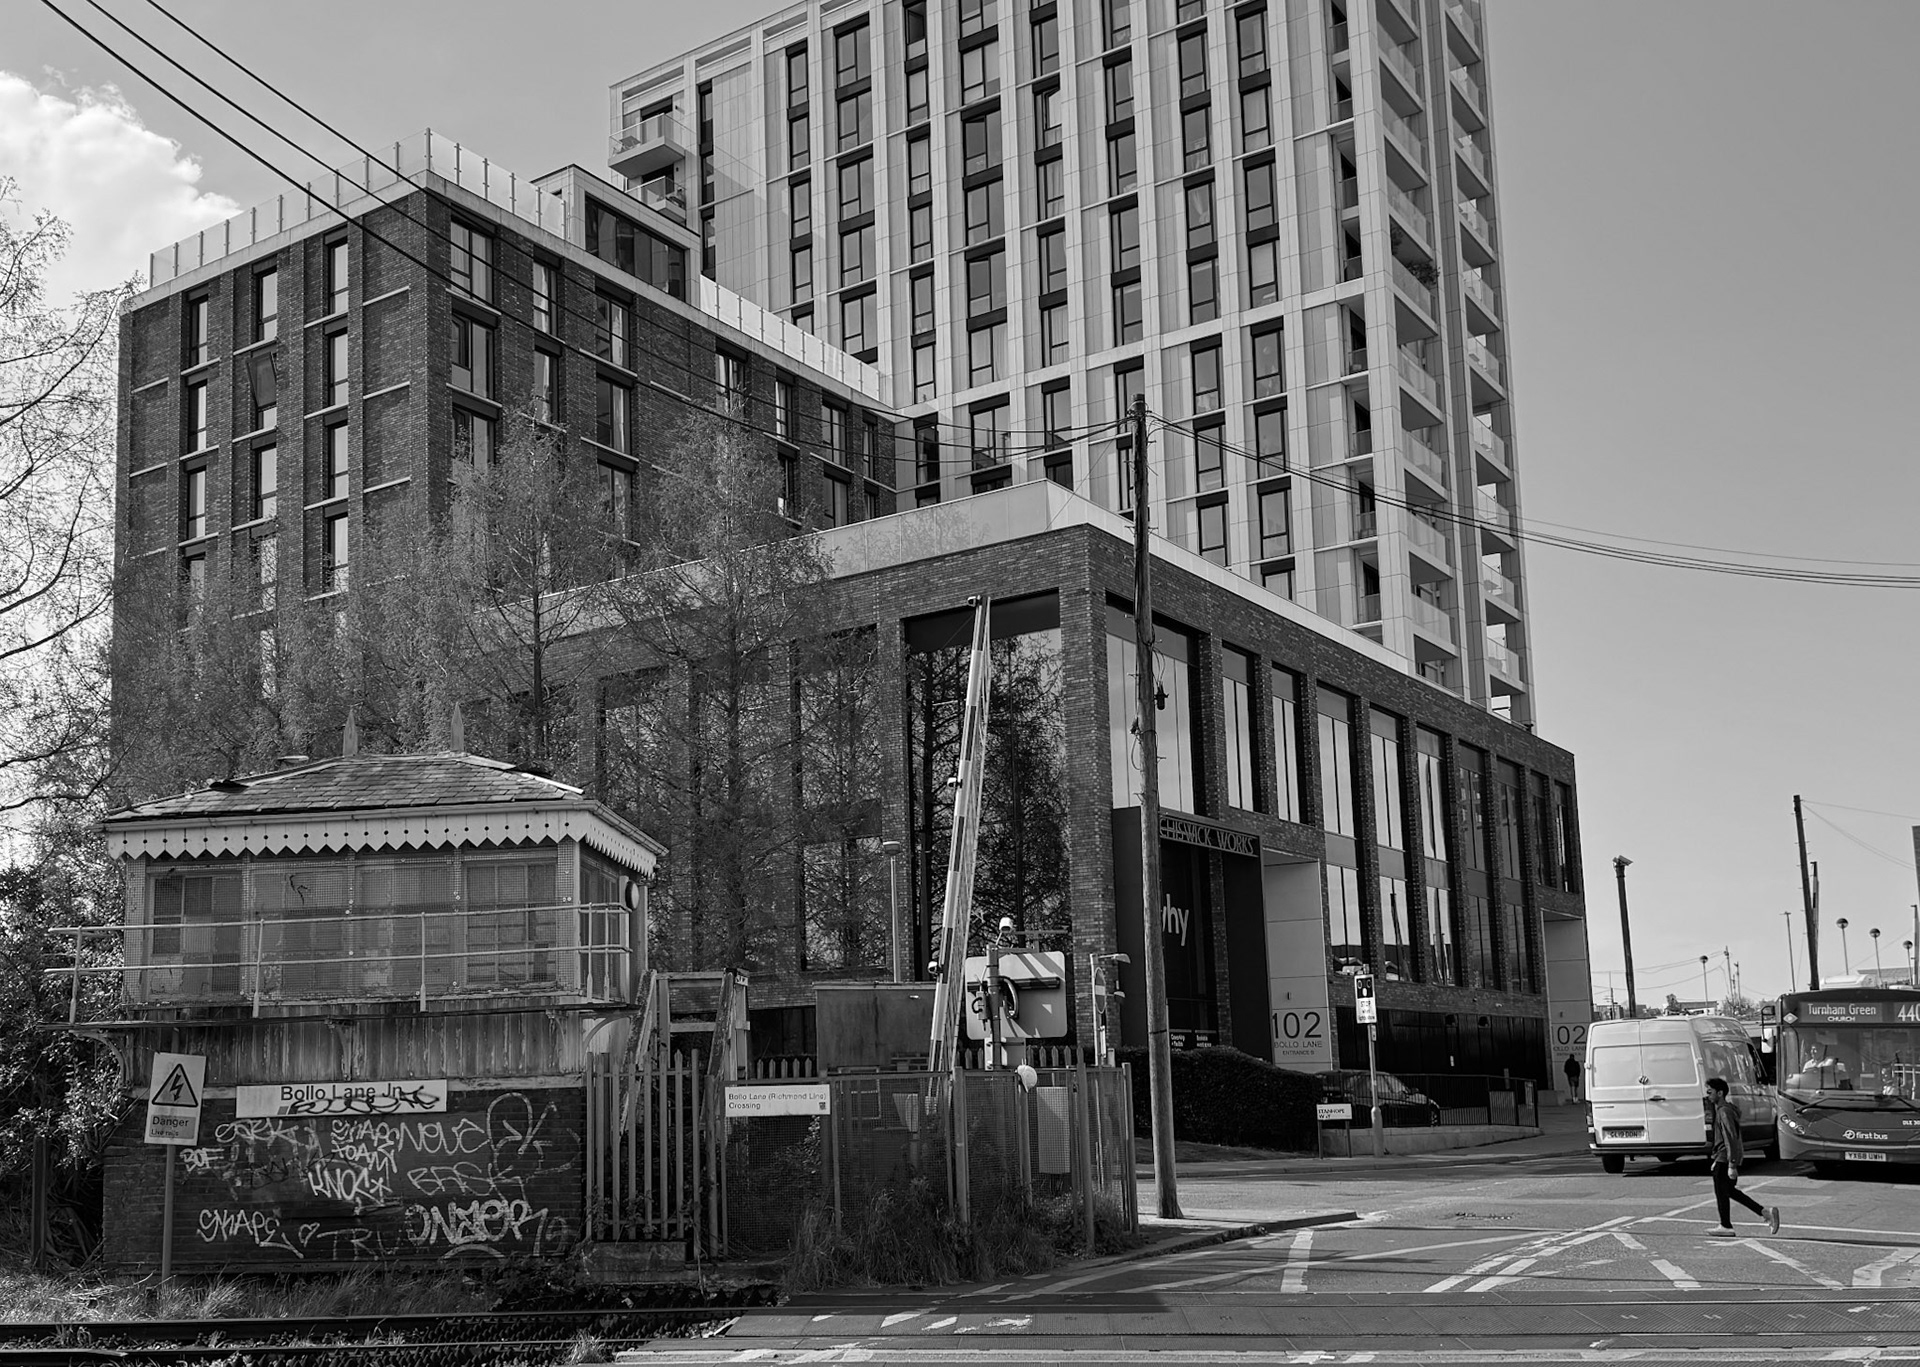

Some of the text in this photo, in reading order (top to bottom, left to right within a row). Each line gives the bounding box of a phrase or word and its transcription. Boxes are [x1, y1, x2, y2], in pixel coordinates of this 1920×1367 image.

[1216, 829, 1254, 855] WORKS
[1808, 1003, 1877, 1015] Turnham Green
[1272, 1011, 1322, 1039] 102
[1273, 1040, 1323, 1049] BOLLO LANE
[281, 1085, 326, 1101] Bollo
[332, 1084, 376, 1102] Lane
[728, 1102, 761, 1110] Crossing
[152, 1116, 190, 1127] Danger
[1856, 1131, 1888, 1140] first bus
